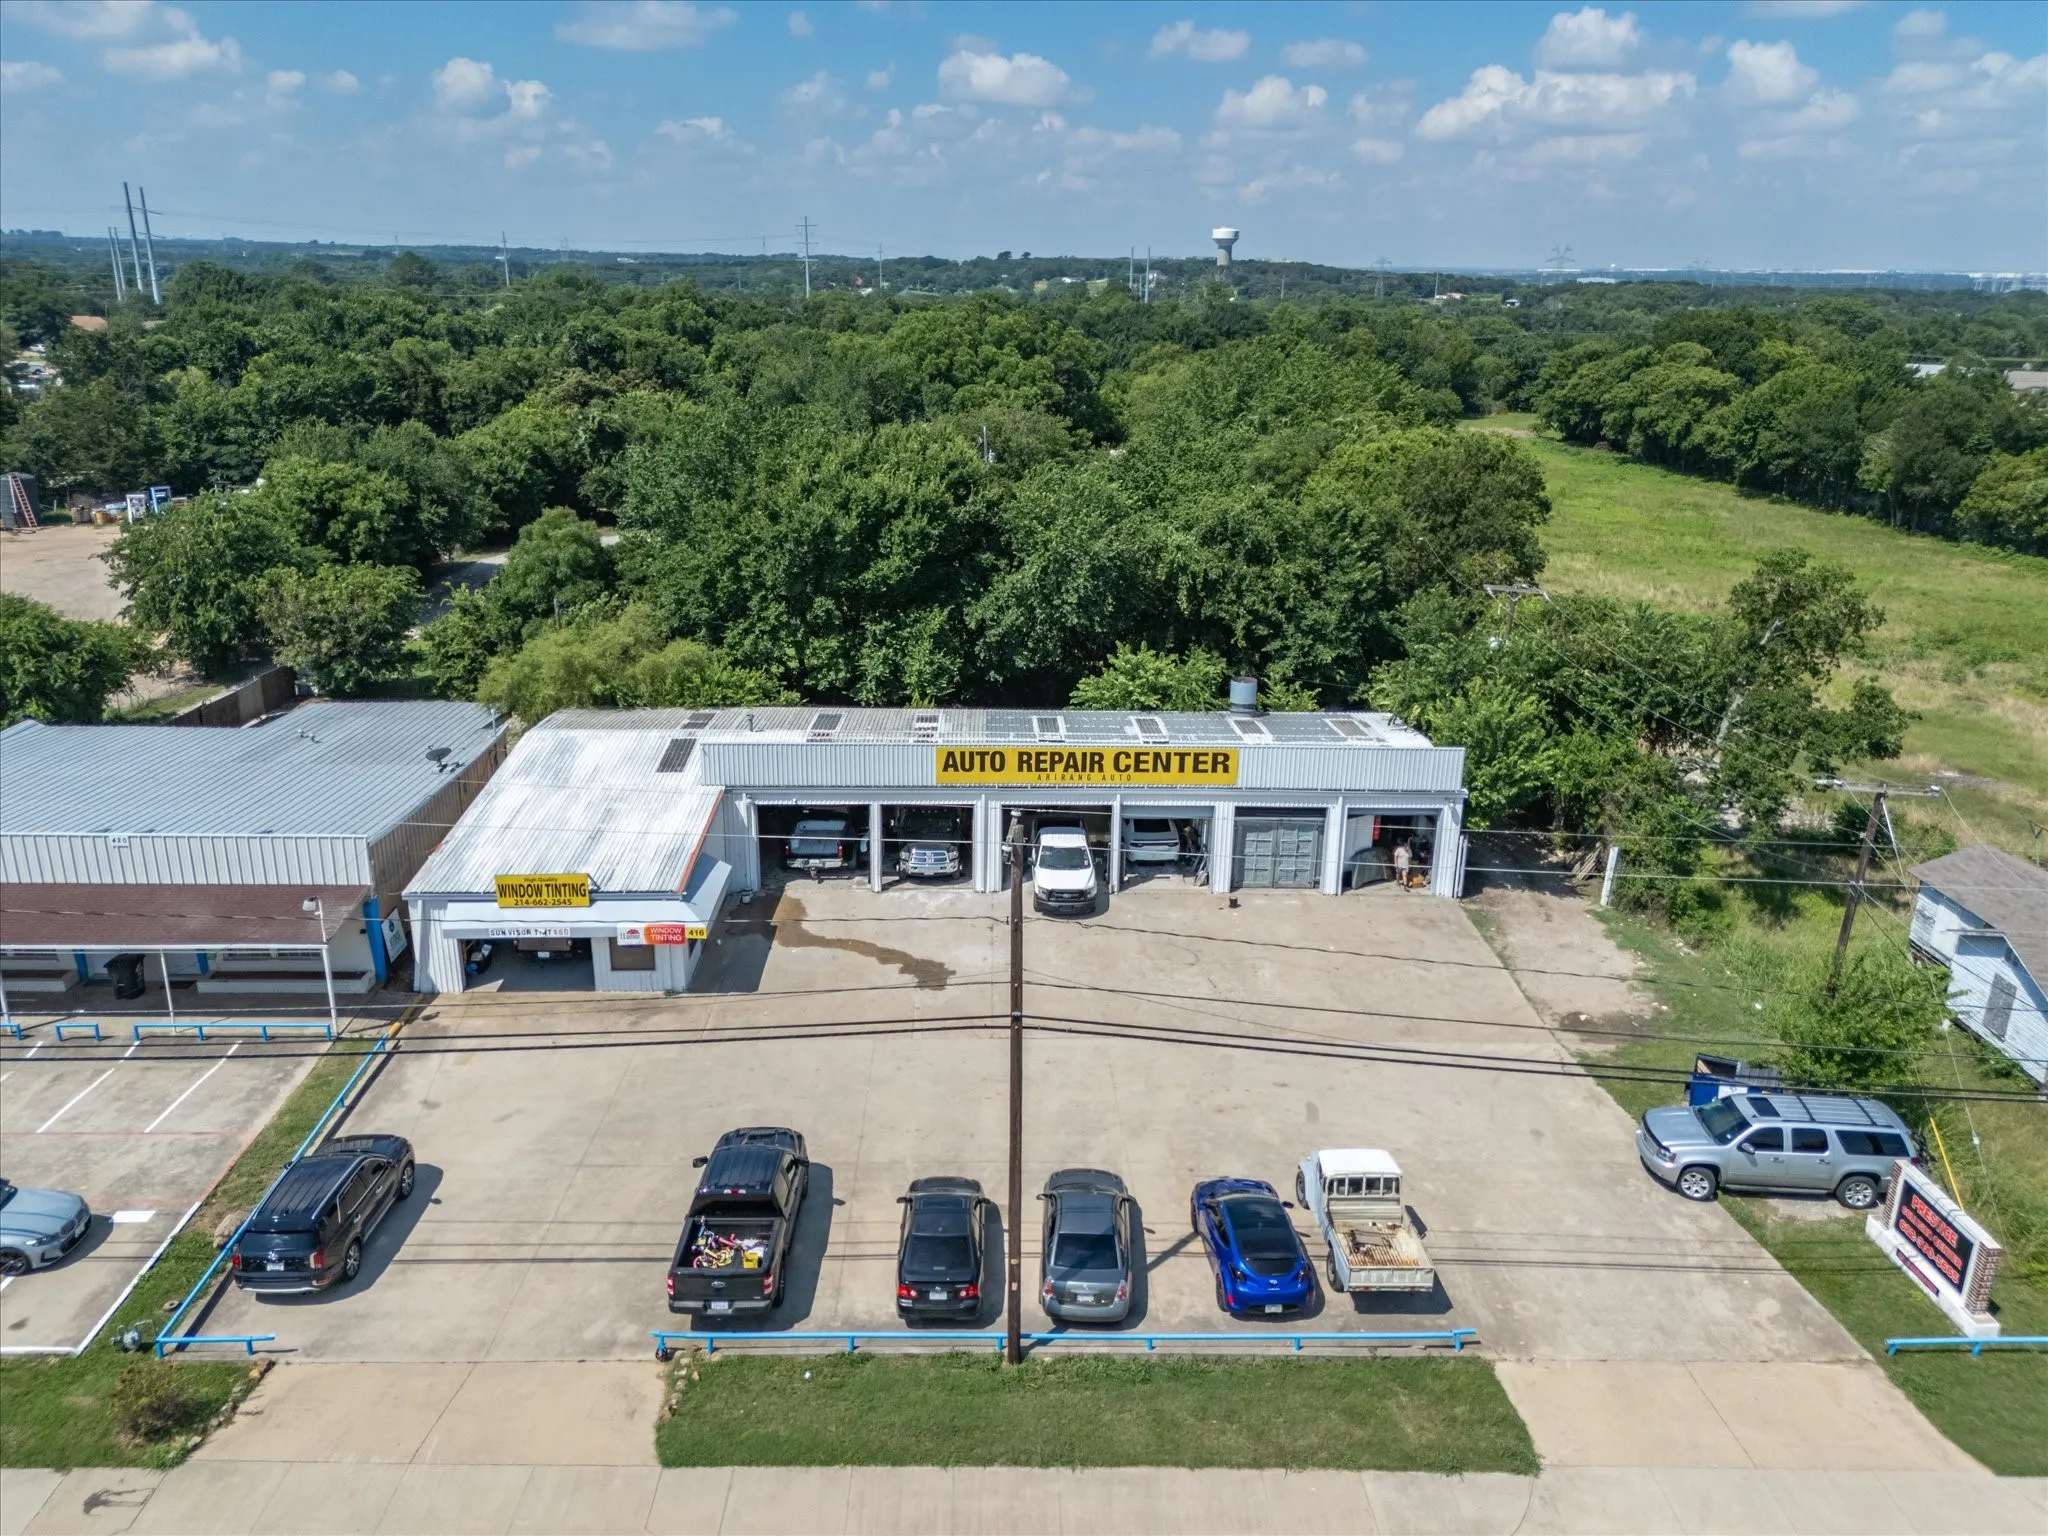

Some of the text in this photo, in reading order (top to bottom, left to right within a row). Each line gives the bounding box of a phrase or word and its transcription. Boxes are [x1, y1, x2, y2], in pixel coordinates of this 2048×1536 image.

[942, 751, 1230, 773] AUTO REPAIR CENTER
[1037, 773, 1132, 781] ARIRANG AUTO
[497, 883, 587, 898] WINDOW TINTING
[688, 929, 705, 937] 416
[1911, 1194, 1959, 1248] PRESTIGE
[1361, 1270, 1421, 1283] TOYOTA
